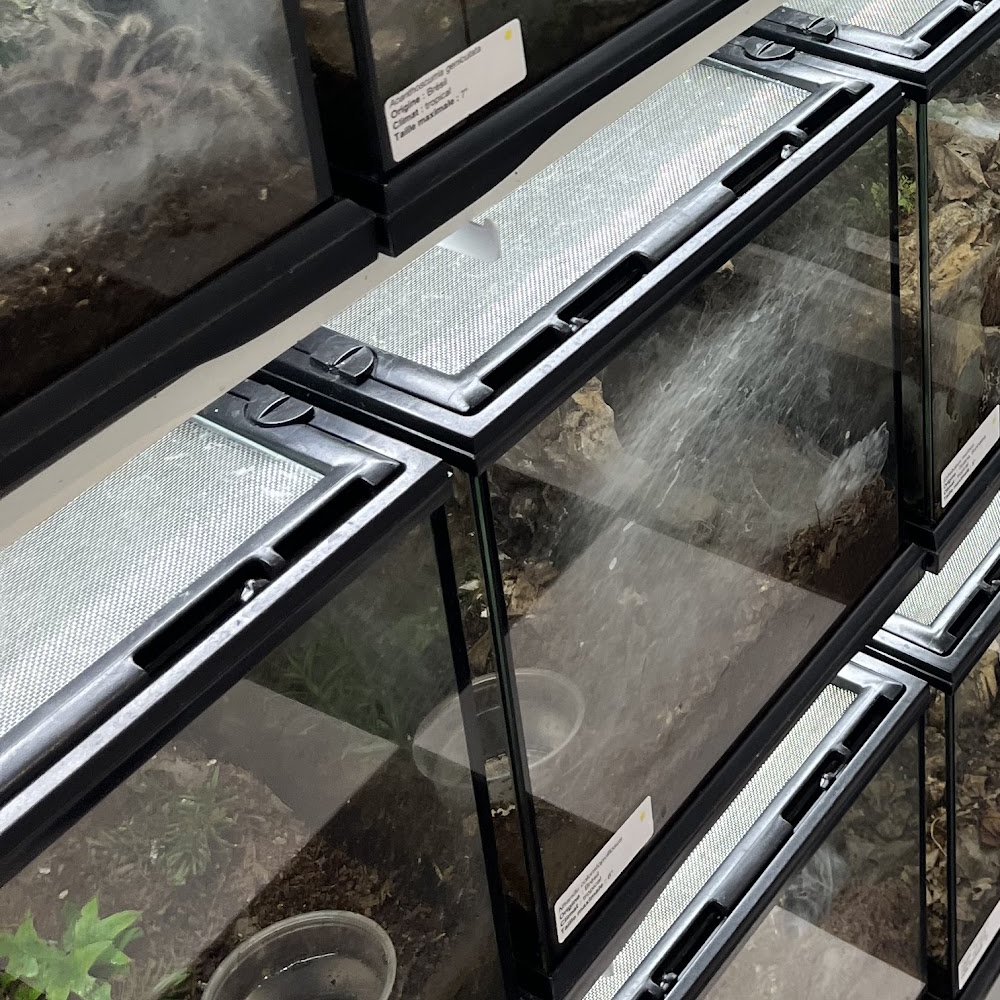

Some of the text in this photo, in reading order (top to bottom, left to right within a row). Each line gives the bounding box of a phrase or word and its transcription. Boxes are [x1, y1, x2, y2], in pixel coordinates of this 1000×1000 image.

[391, 95, 420, 121] Origine
[392, 107, 419, 131] Climat
[425, 87, 452, 110] tropical
[394, 122, 416, 142] Taille
[417, 97, 454, 127] maximale
[560, 893, 580, 921] Origine
[561, 913, 576, 935] Taille
[577, 881, 603, 916] maximale
[561, 902, 579, 928] Climat
